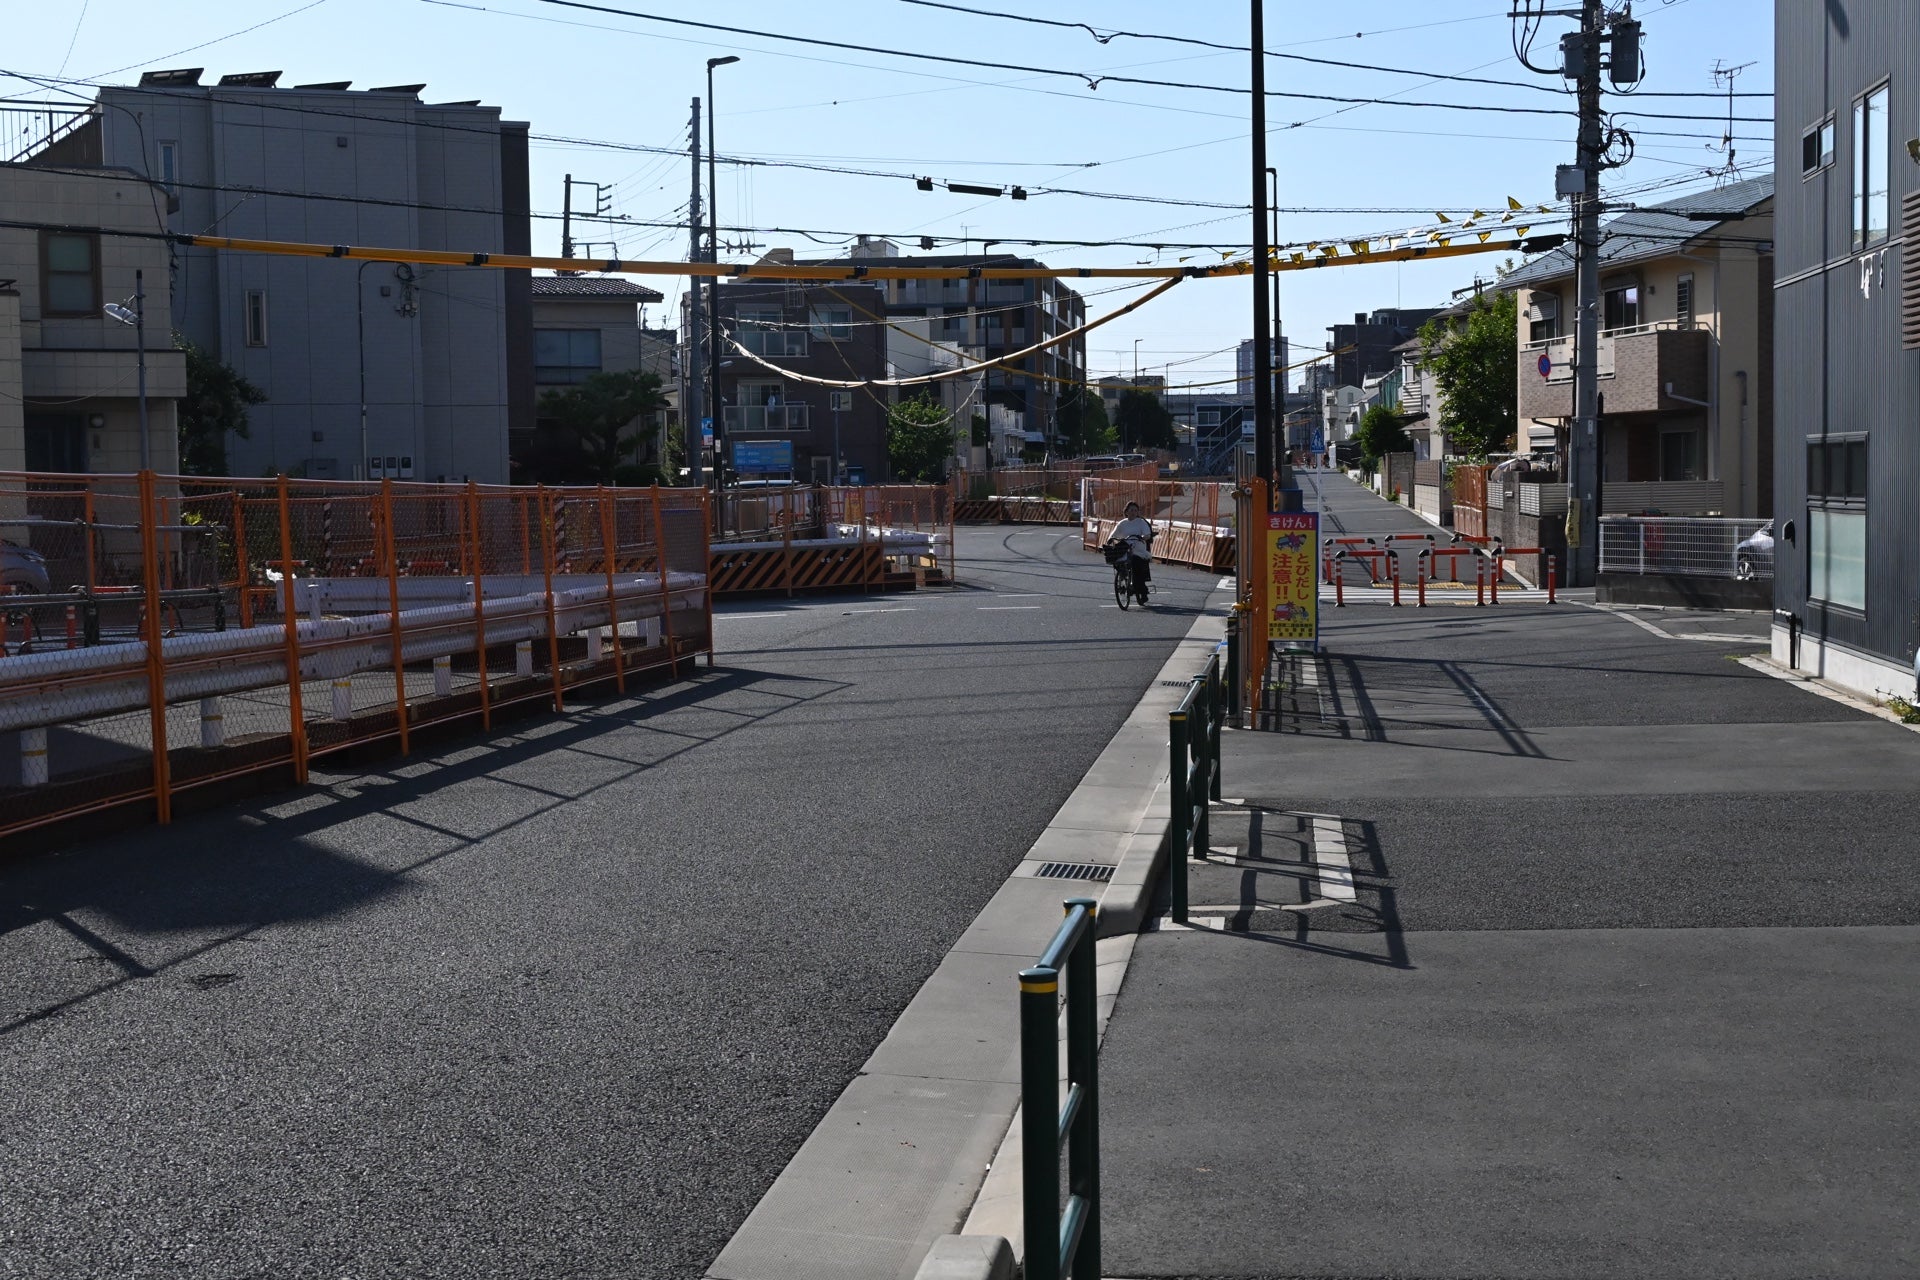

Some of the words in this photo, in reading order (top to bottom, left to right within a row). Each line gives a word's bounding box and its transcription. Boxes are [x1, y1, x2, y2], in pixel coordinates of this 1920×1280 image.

[1270, 517, 1312, 528] きけん!
[1272, 553, 1292, 600] 注意!!
[1296, 553, 1310, 600] とびだし
